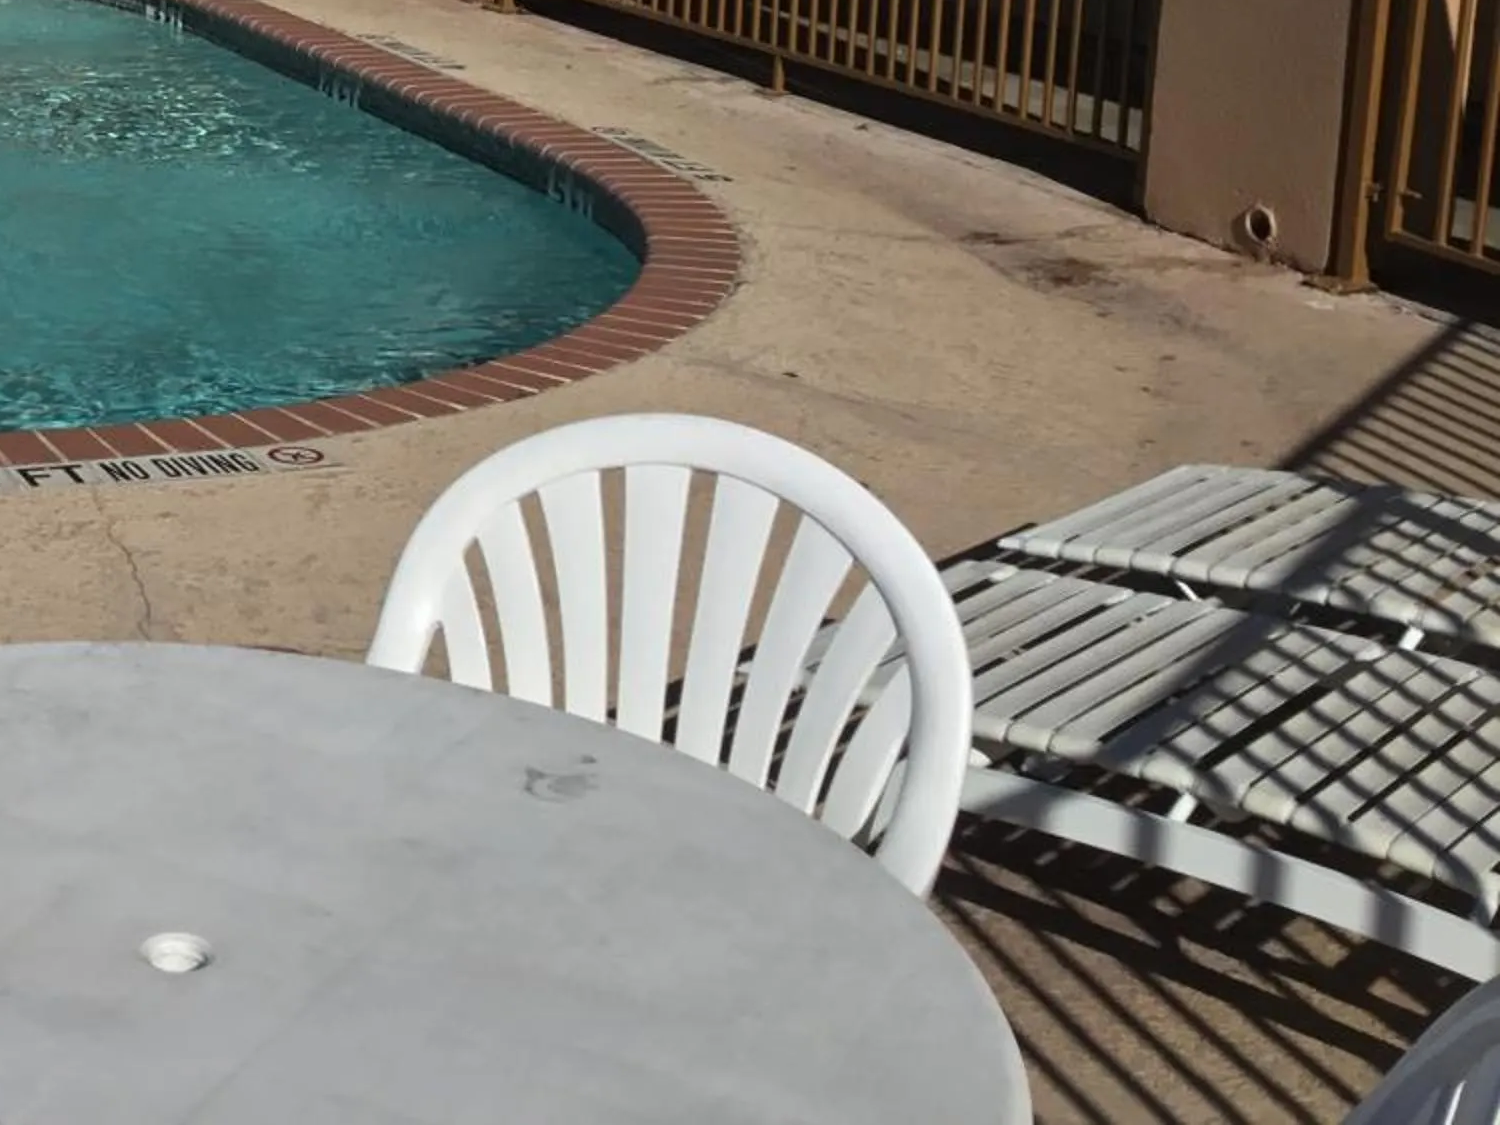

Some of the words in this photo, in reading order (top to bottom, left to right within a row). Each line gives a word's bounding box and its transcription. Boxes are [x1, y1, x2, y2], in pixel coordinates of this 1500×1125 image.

[15, 464, 85, 487] FT
[98, 460, 150, 483] NO
[150, 452, 260, 478] DIVING
